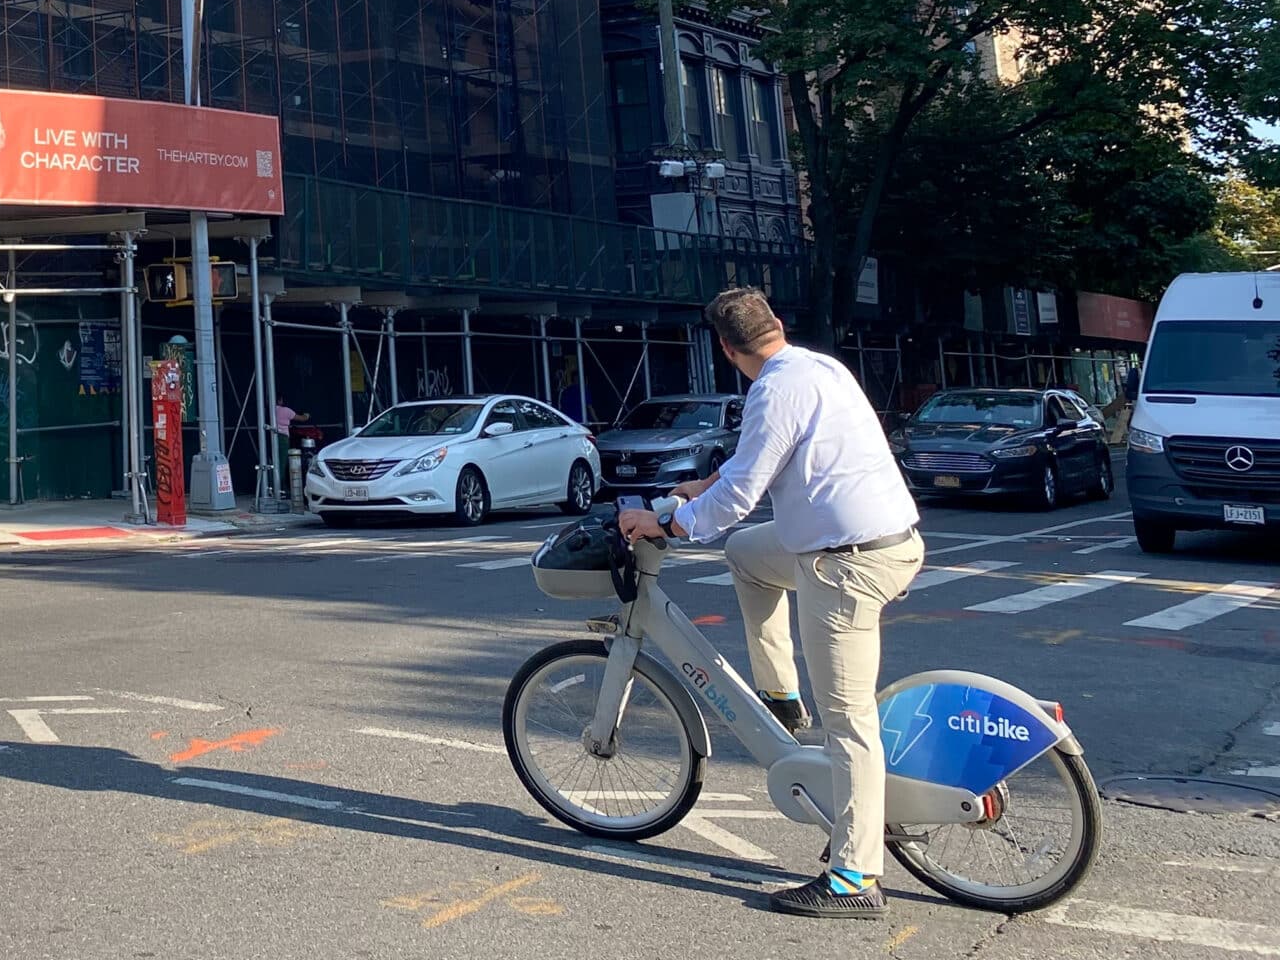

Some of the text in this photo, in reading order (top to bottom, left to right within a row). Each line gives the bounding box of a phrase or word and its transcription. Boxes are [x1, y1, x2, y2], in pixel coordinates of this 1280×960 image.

[33, 128, 128, 150] LIVE WITH
[20, 151, 140, 175] CHARACTER
[157, 148, 249, 169] THEHARTBY.COM
[682, 662, 737, 722] citi bike
[948, 713, 1030, 741] citi bike
